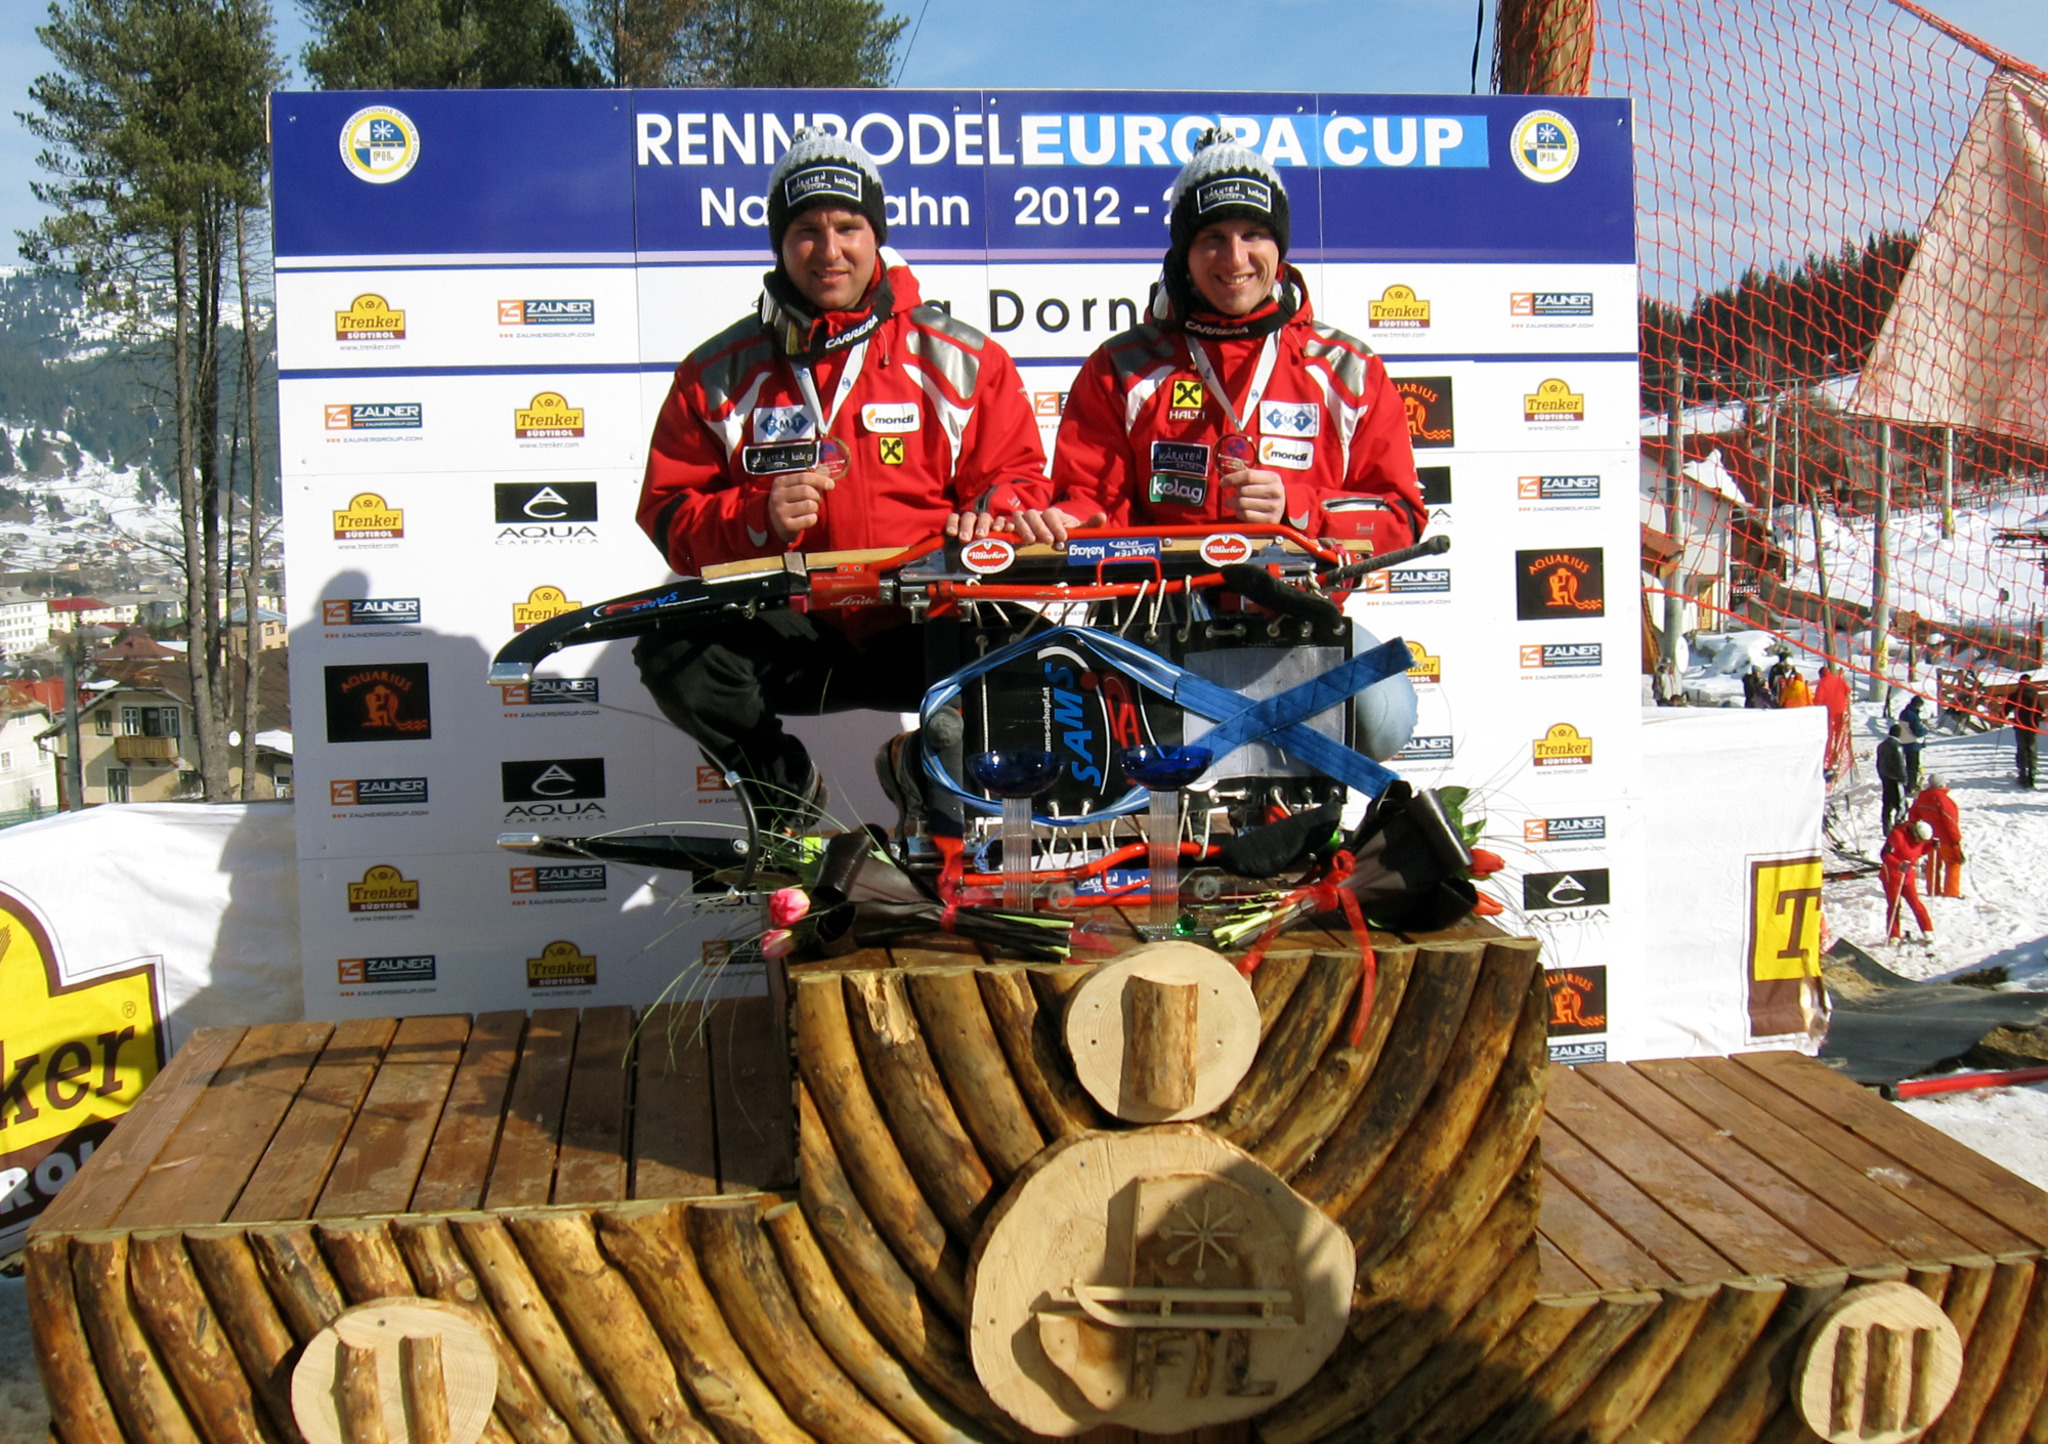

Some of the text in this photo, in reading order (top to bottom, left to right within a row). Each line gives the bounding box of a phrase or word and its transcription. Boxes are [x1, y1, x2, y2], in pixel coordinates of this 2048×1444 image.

[1323, 116, 1464, 167] CUP
[373, 150, 394, 162] FIL
[701, 186, 970, 226] Naahn
[1014, 187, 1121, 226] 2012
[1535, 294, 1591, 305] ZAUNER
[526, 302, 592, 312] ZAUNER
[989, 289, 1138, 333] Dorn
[1372, 305, 1426, 317] Trenker
[340, 315, 401, 329] Trenker
[1184, 320, 1250, 336] CARRERA
[346, 331, 395, 340] SÜDTIROL
[825, 314, 879, 350] CARRERA
[353, 406, 420, 417] ZAUNER
[1528, 399, 1581, 411] Trenker
[519, 414, 580, 427] Trenker
[874, 414, 915, 424] mondi
[526, 429, 574, 437] SÜDTIROL
[1270, 451, 1309, 462] mondi
[1541, 477, 1599, 488] ZAUNER
[1152, 476, 1203, 503] kelag
[338, 514, 400, 527] Trenker
[345, 530, 393, 539] SÜDTIROL
[497, 526, 597, 539] AQUA
[1068, 544, 1106, 559] kelag
[1528, 554, 1591, 575] AQUARIUS
[1390, 571, 1449, 582] ZAUNER
[352, 601, 418, 612] ZAUNER
[517, 607, 570, 620] Trenk
[1544, 645, 1600, 657] ZAUNER
[341, 671, 413, 693] AQUARIUS
[1043, 662, 1102, 788] SAMS
[1403, 738, 1451, 749] AUNER
[1536, 741, 1588, 755] Trenker
[360, 780, 424, 792] ZAUNER
[505, 802, 605, 817] AQUA
[1548, 818, 1604, 830] ZAUNER
[538, 868, 603, 880] ZAUNER
[353, 886, 415, 900] Trenker
[1525, 908, 1609, 925] AQUA
[367, 958, 433, 970] ZAUNER
[531, 962, 592, 976] Trenker
[1550, 1043, 1605, 1056] ZAUNER
[1131, 1329, 1278, 1400] FIL
